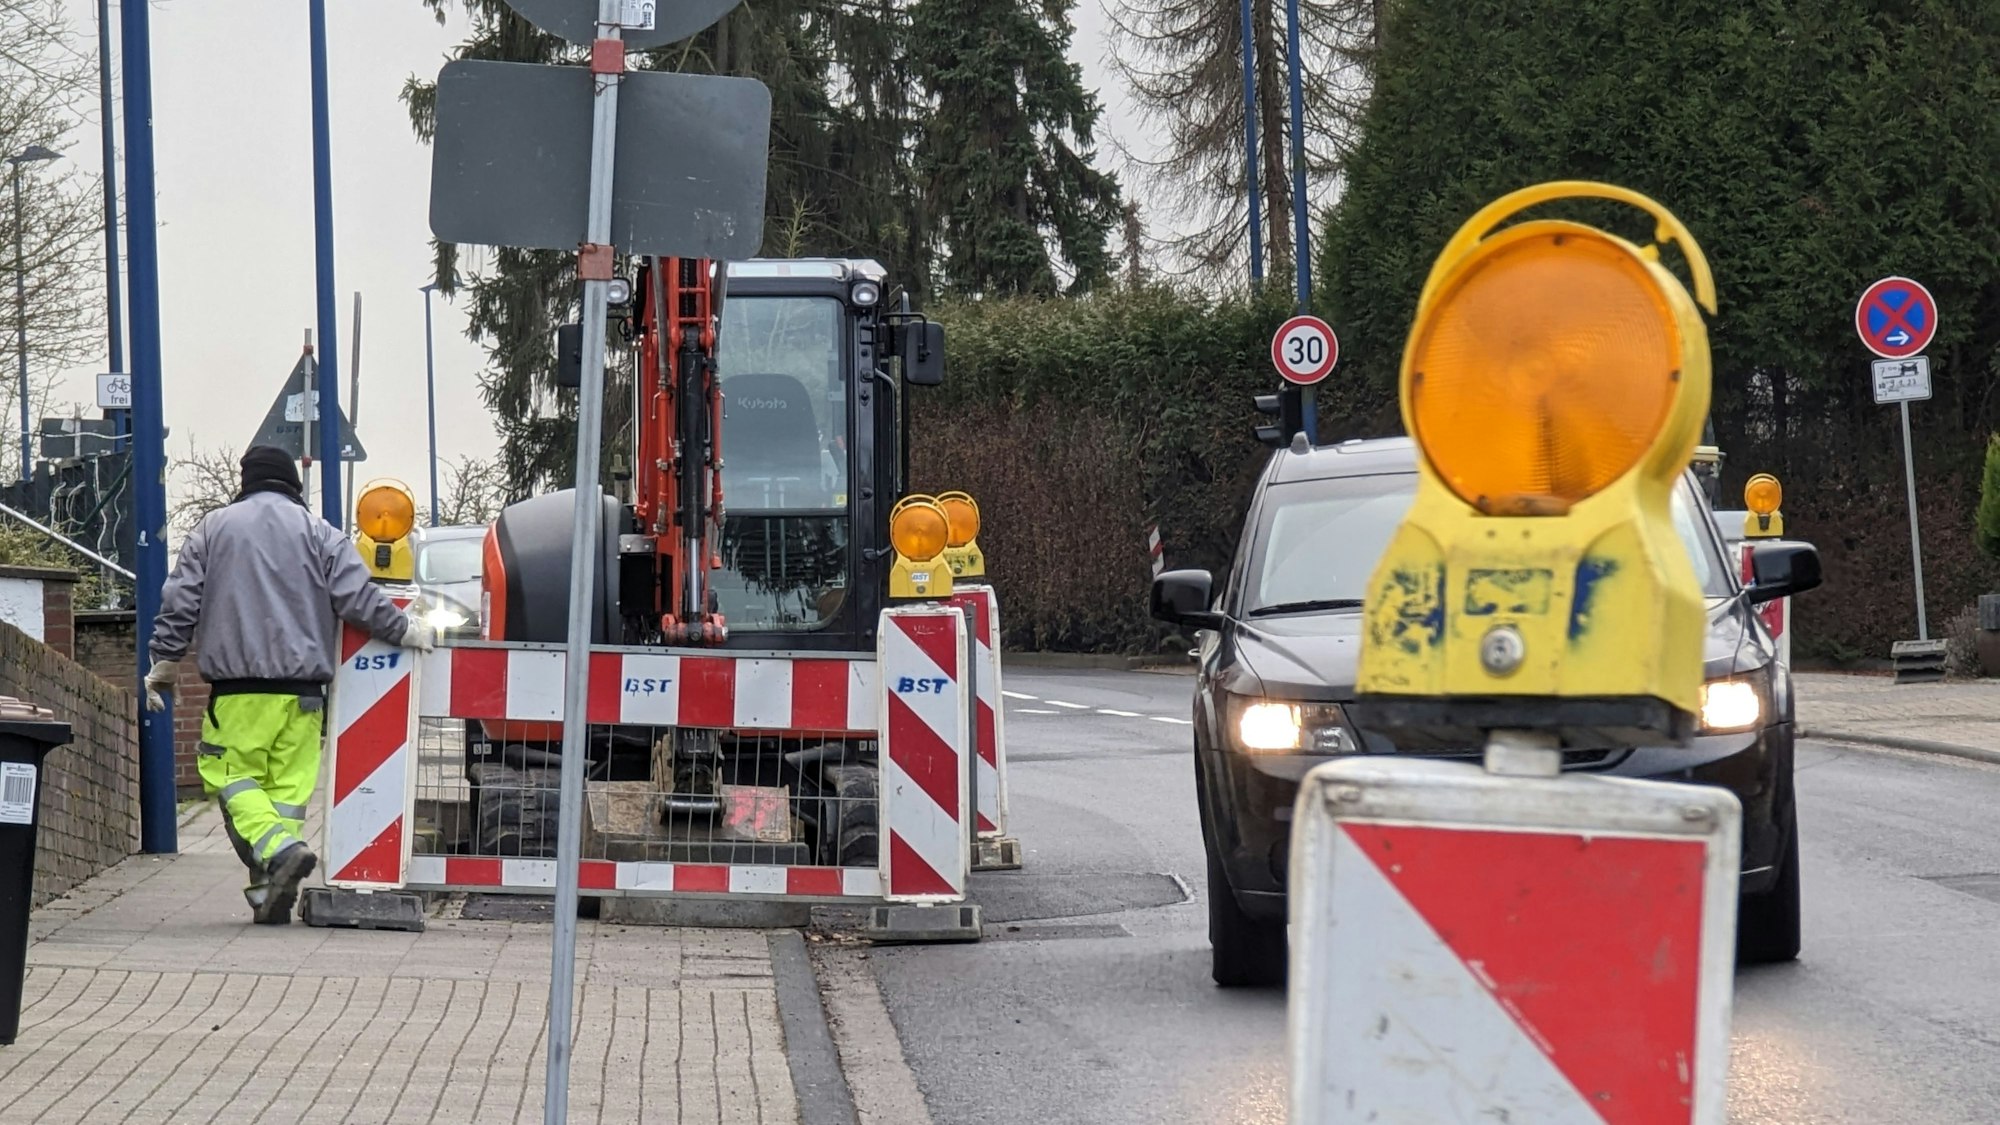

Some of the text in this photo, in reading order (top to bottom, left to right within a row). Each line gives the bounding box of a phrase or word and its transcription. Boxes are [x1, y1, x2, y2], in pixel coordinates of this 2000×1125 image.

[1288, 336, 1323, 364] 30
[111, 394, 128, 404] frei
[737, 397, 788, 409] Kubota
[355, 653, 401, 670] BST
[625, 678, 673, 693] BST
[897, 677, 949, 694] BST
